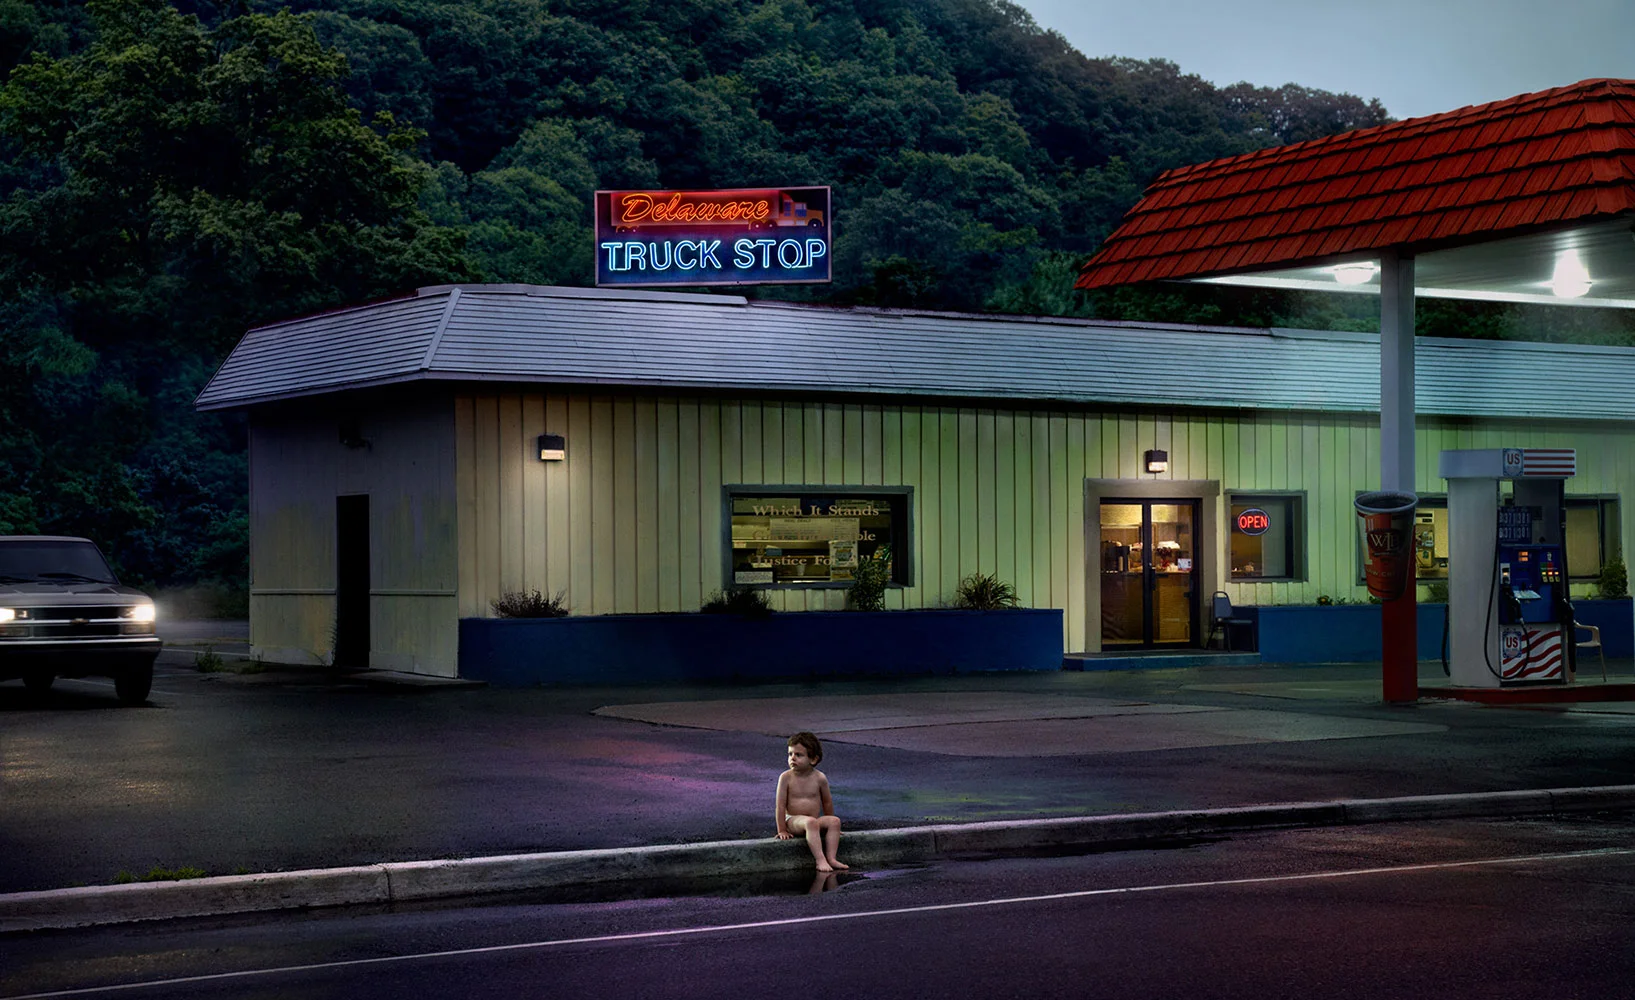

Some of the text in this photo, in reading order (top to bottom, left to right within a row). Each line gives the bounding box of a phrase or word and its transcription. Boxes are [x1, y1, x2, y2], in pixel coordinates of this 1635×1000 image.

[622, 192, 769, 222] Delaware
[601, 238, 827, 271] TRUCK STOP
[1507, 453, 1520, 465] US
[753, 505, 879, 516] Which It Stands
[1239, 515, 1268, 529] OPEN
[1506, 637, 1518, 648] US
